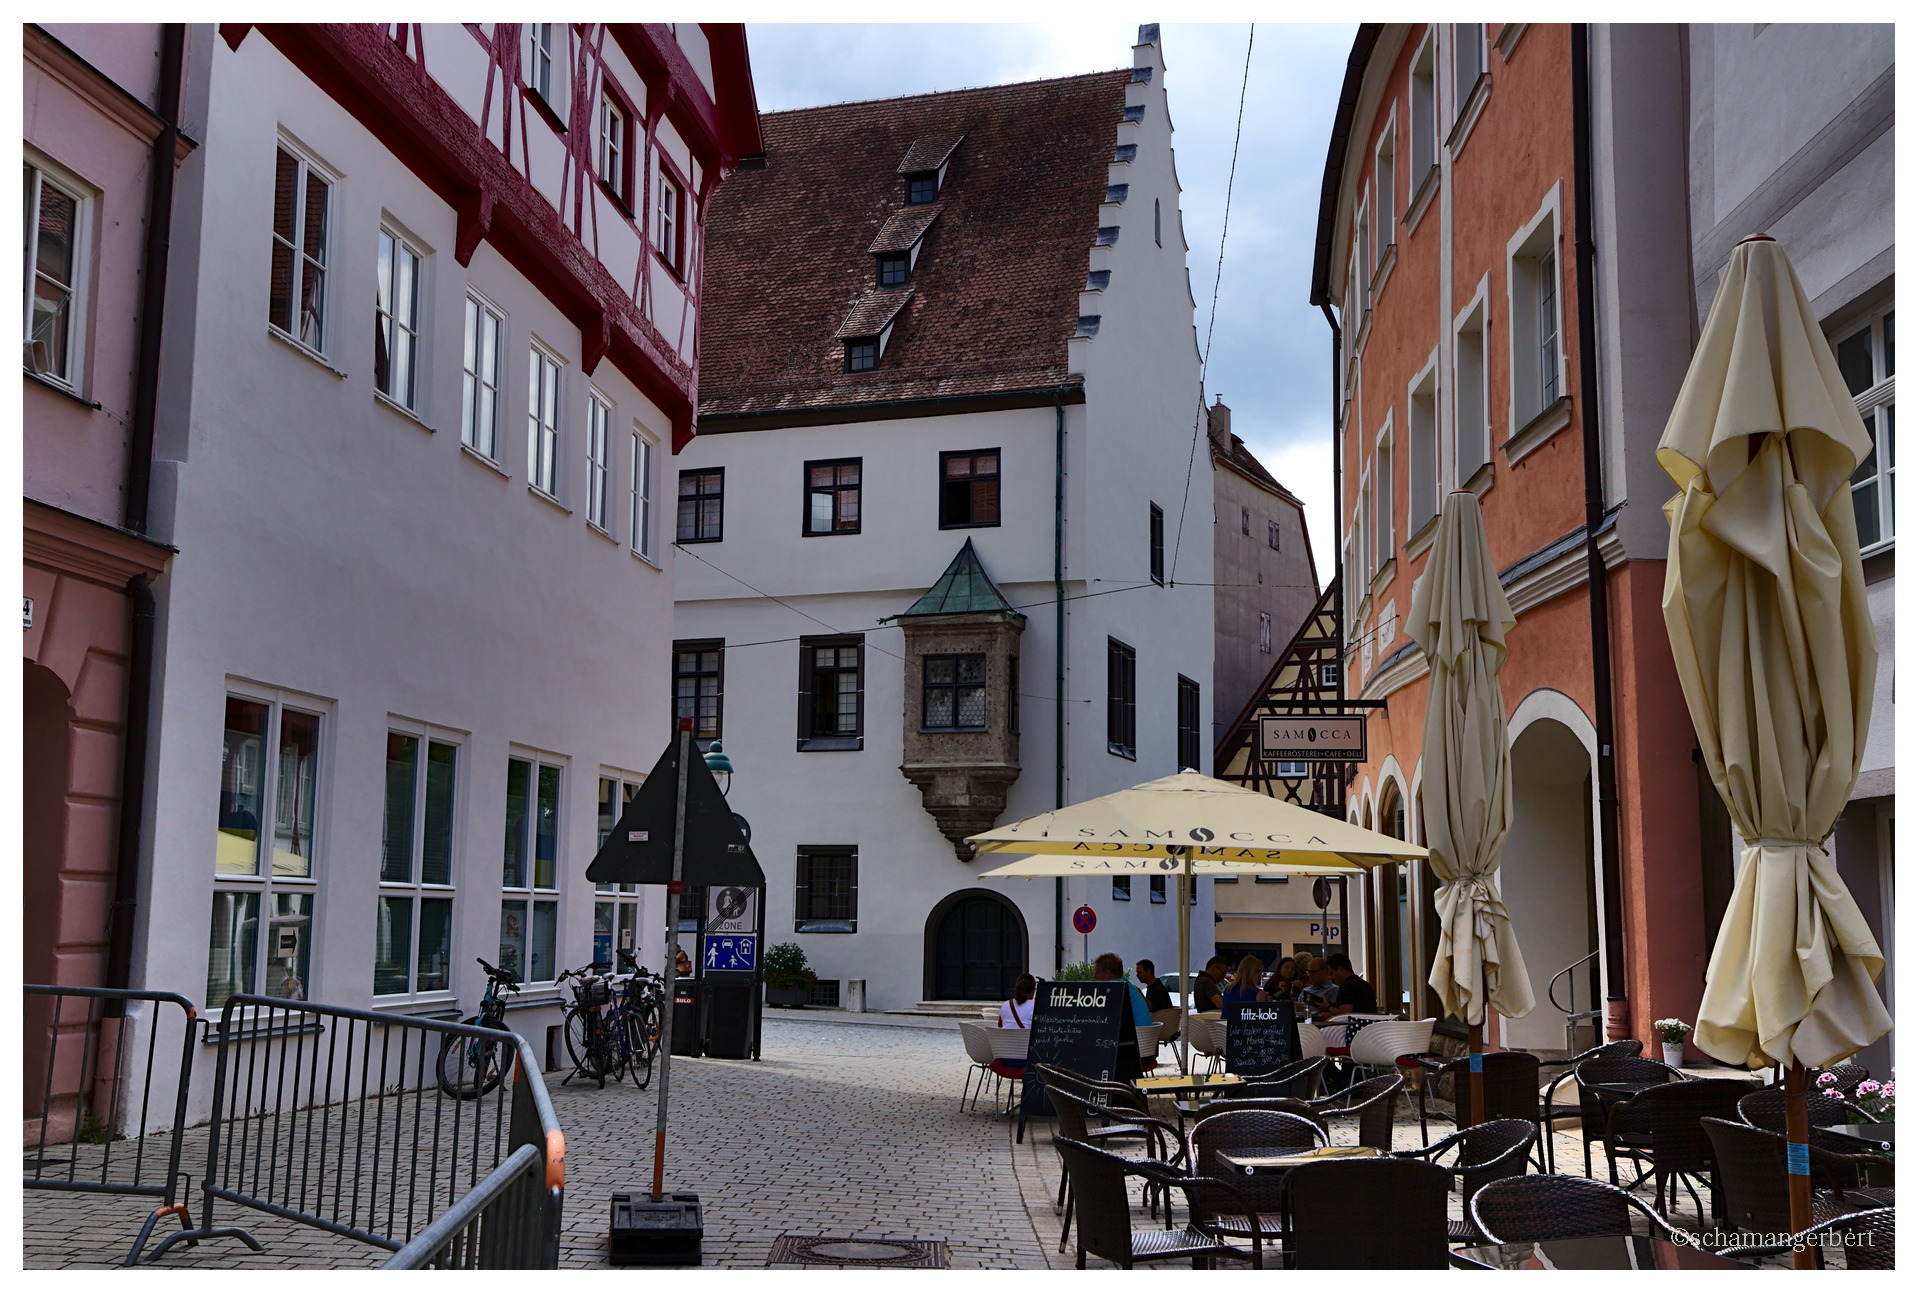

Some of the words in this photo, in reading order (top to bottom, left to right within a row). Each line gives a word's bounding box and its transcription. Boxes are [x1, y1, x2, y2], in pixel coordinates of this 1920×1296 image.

[1273, 727, 1351, 742] SAMOCCA
[1263, 749, 1320, 757] KAFFEERÖSTEREI
[1078, 827, 1328, 845] SAMOCCA
[718, 921, 743, 930] ZONE
[1050, 987, 1107, 1007] fritz-kola
[1241, 1008, 1278, 1020] fritz-kola
